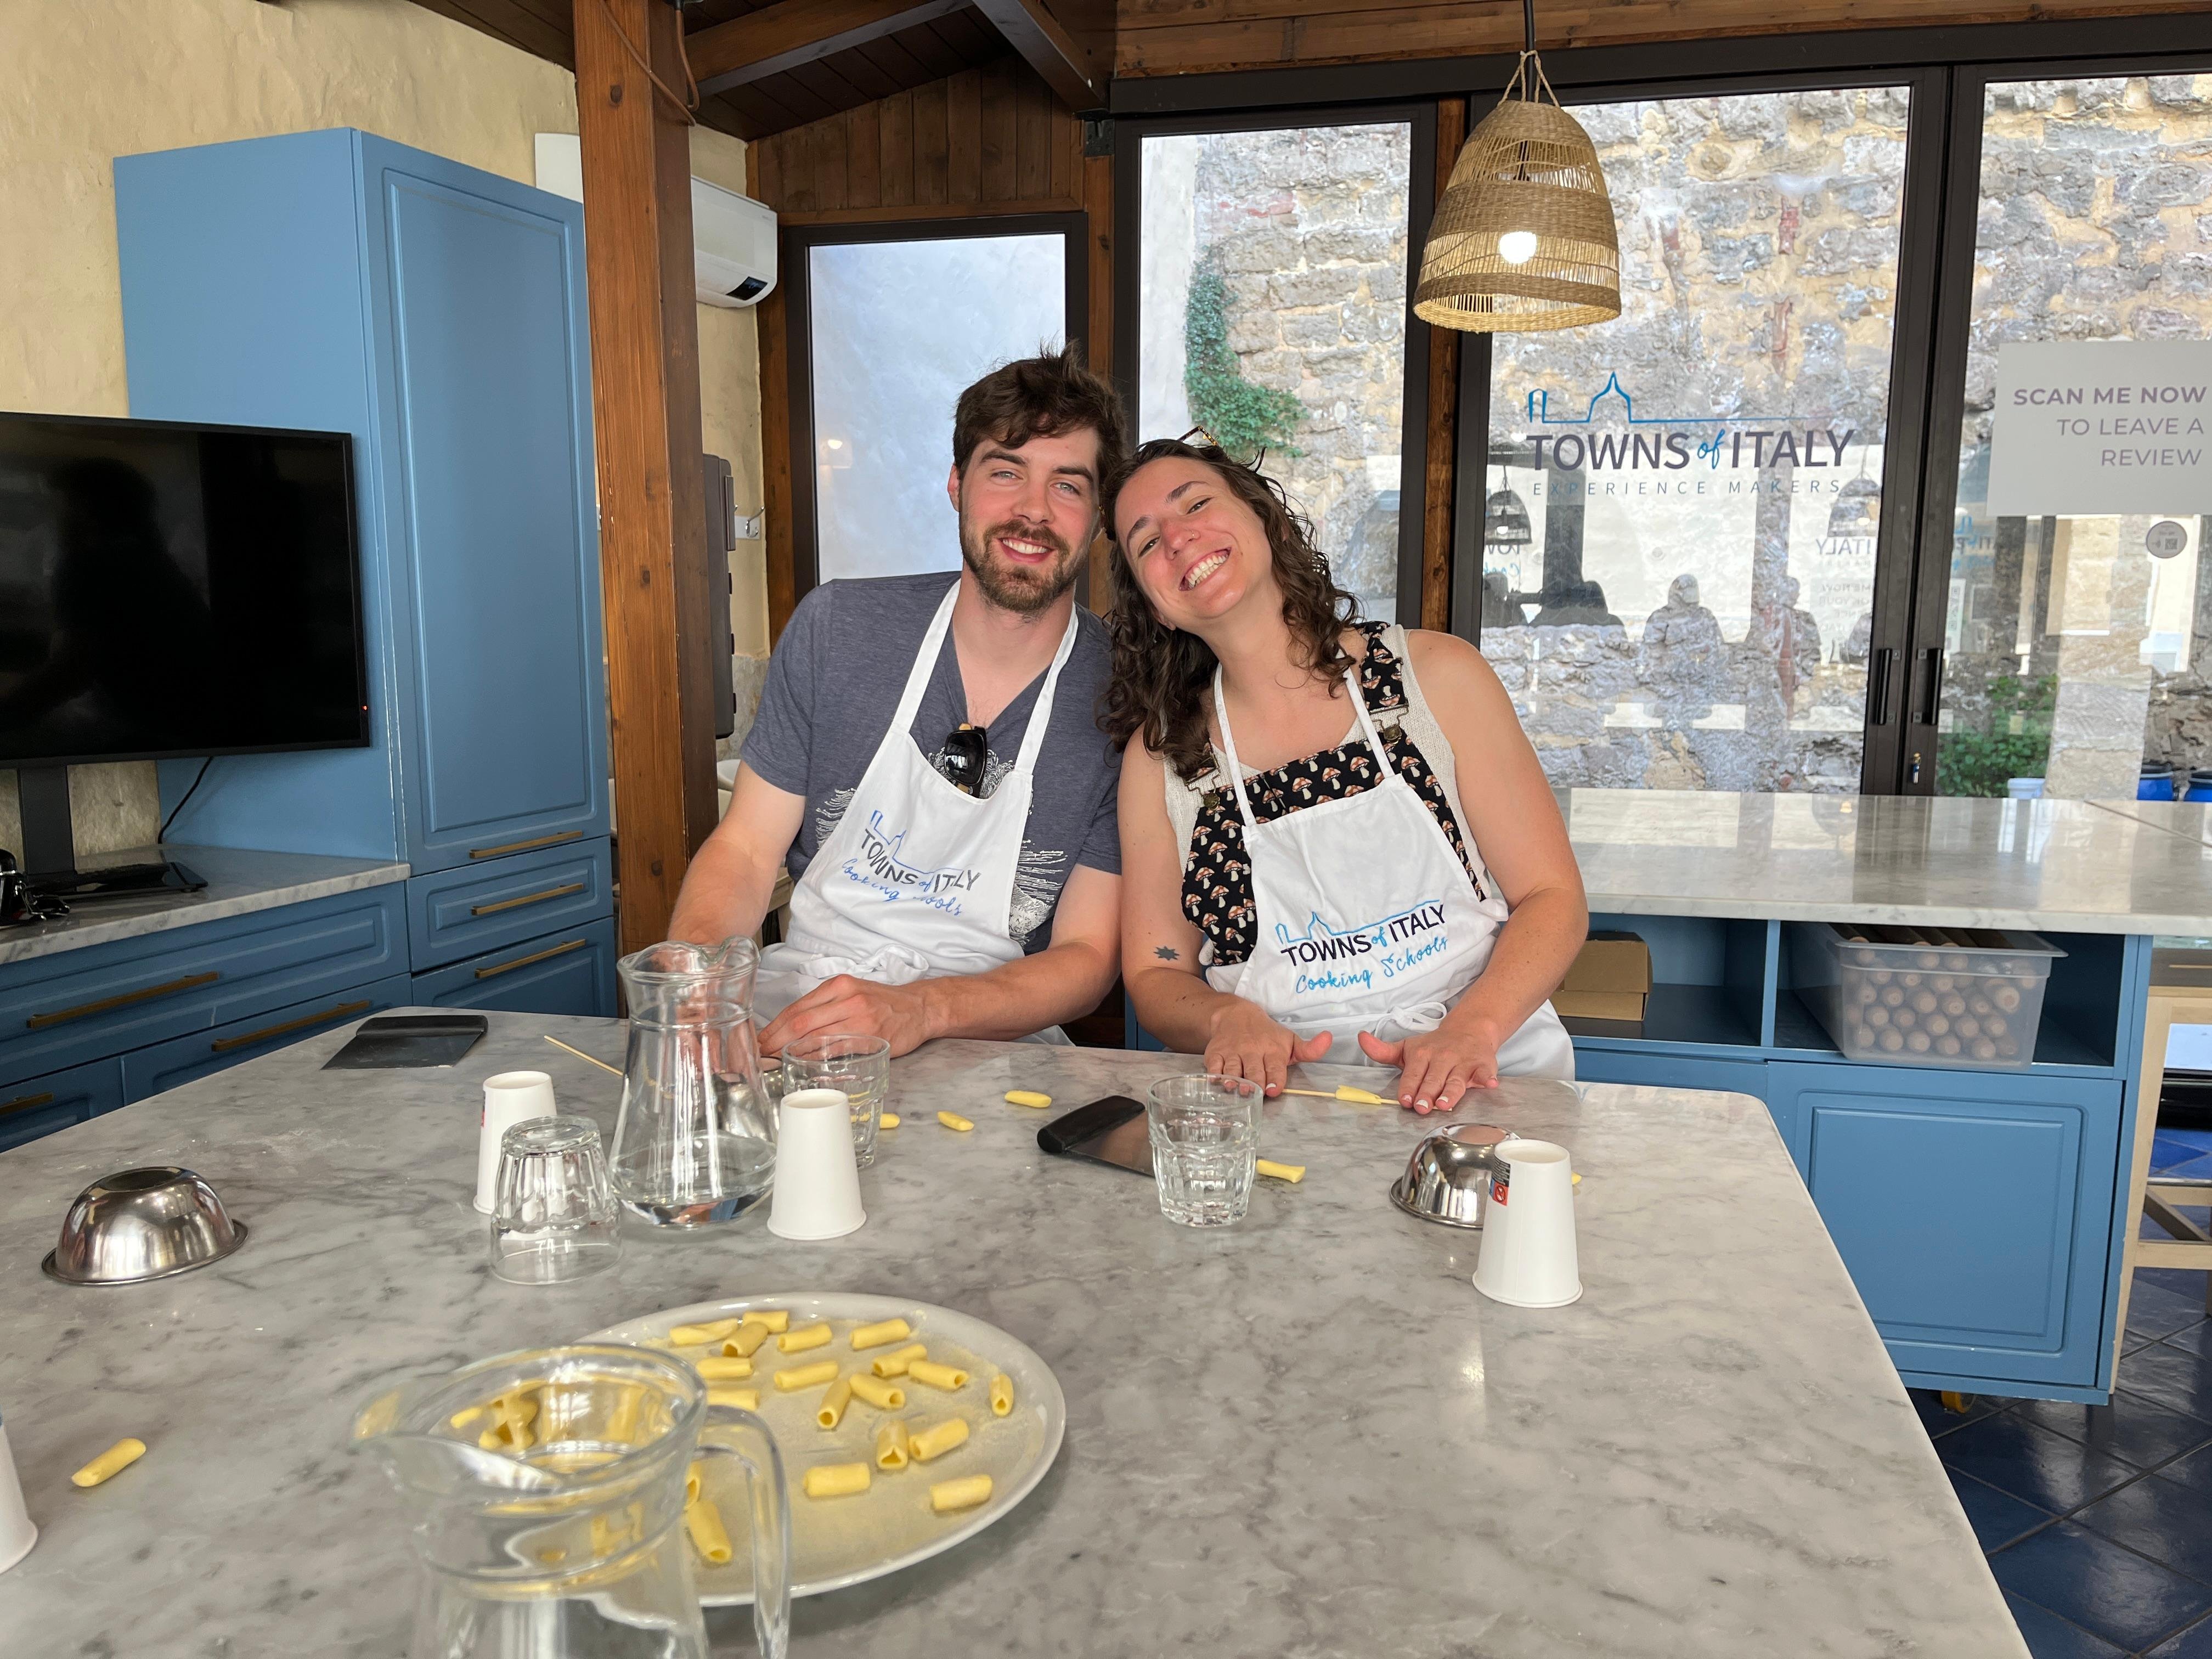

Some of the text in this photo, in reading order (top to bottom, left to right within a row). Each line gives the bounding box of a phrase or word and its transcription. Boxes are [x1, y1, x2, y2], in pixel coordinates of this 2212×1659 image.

[2013, 386, 2207, 405] SCAN ME NOW
[2056, 417, 2204, 436] TO LEAVE A
[1526, 428, 1856, 471] TOWNS of ITALY
[2101, 449, 2203, 466] REVIEW
[1533, 479, 1840, 496] EXPERIENCE MAKERS
[861, 828, 981, 893] TOWNS of ITLY
[1280, 904, 1447, 966] TOWNS of ITALY
[1296, 936, 1449, 994] Cooking Schools
